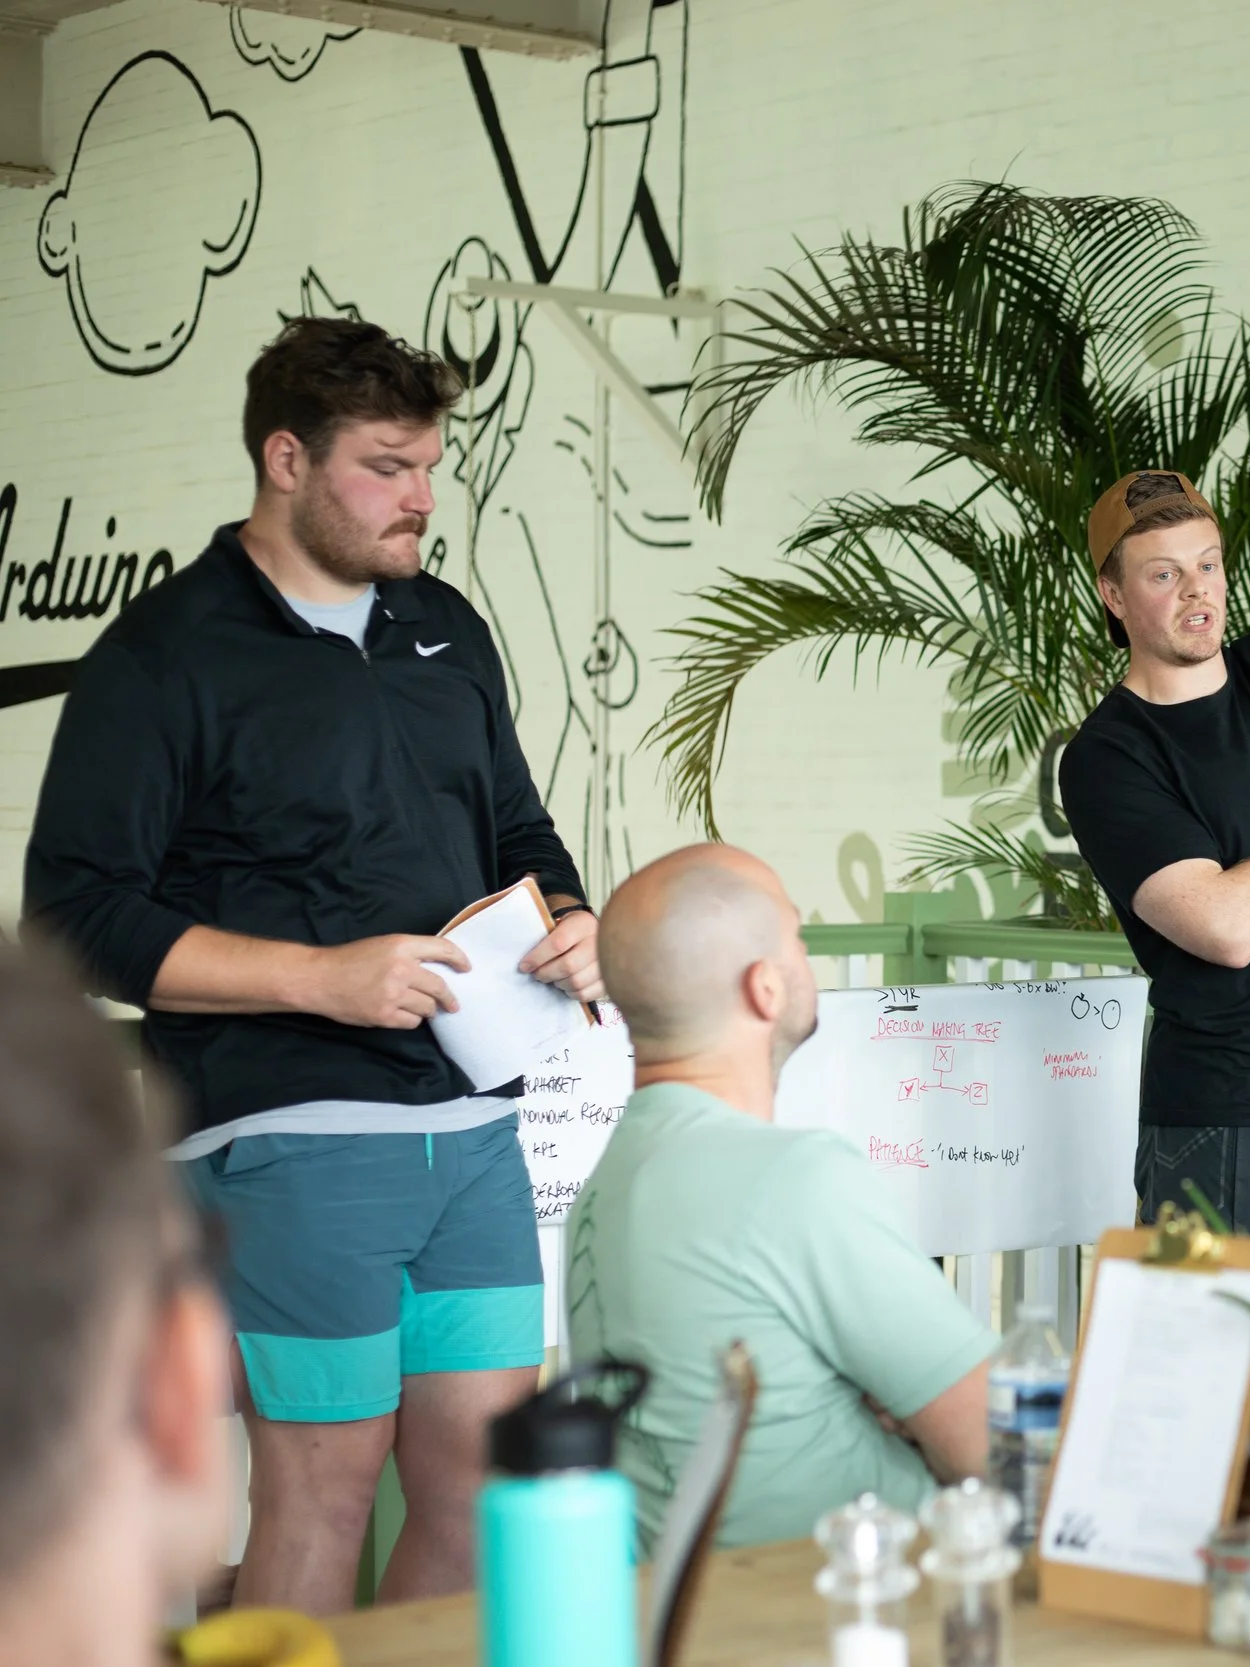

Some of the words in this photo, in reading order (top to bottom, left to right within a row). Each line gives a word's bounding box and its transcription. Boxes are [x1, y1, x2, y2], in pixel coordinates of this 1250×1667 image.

[877, 1017, 925, 1035] DECISION
[932, 1021, 965, 1038] MAKING
[972, 1021, 1001, 1038] TREE
[938, 1048, 948, 1061] X
[533, 1141, 558, 1159] KPI
